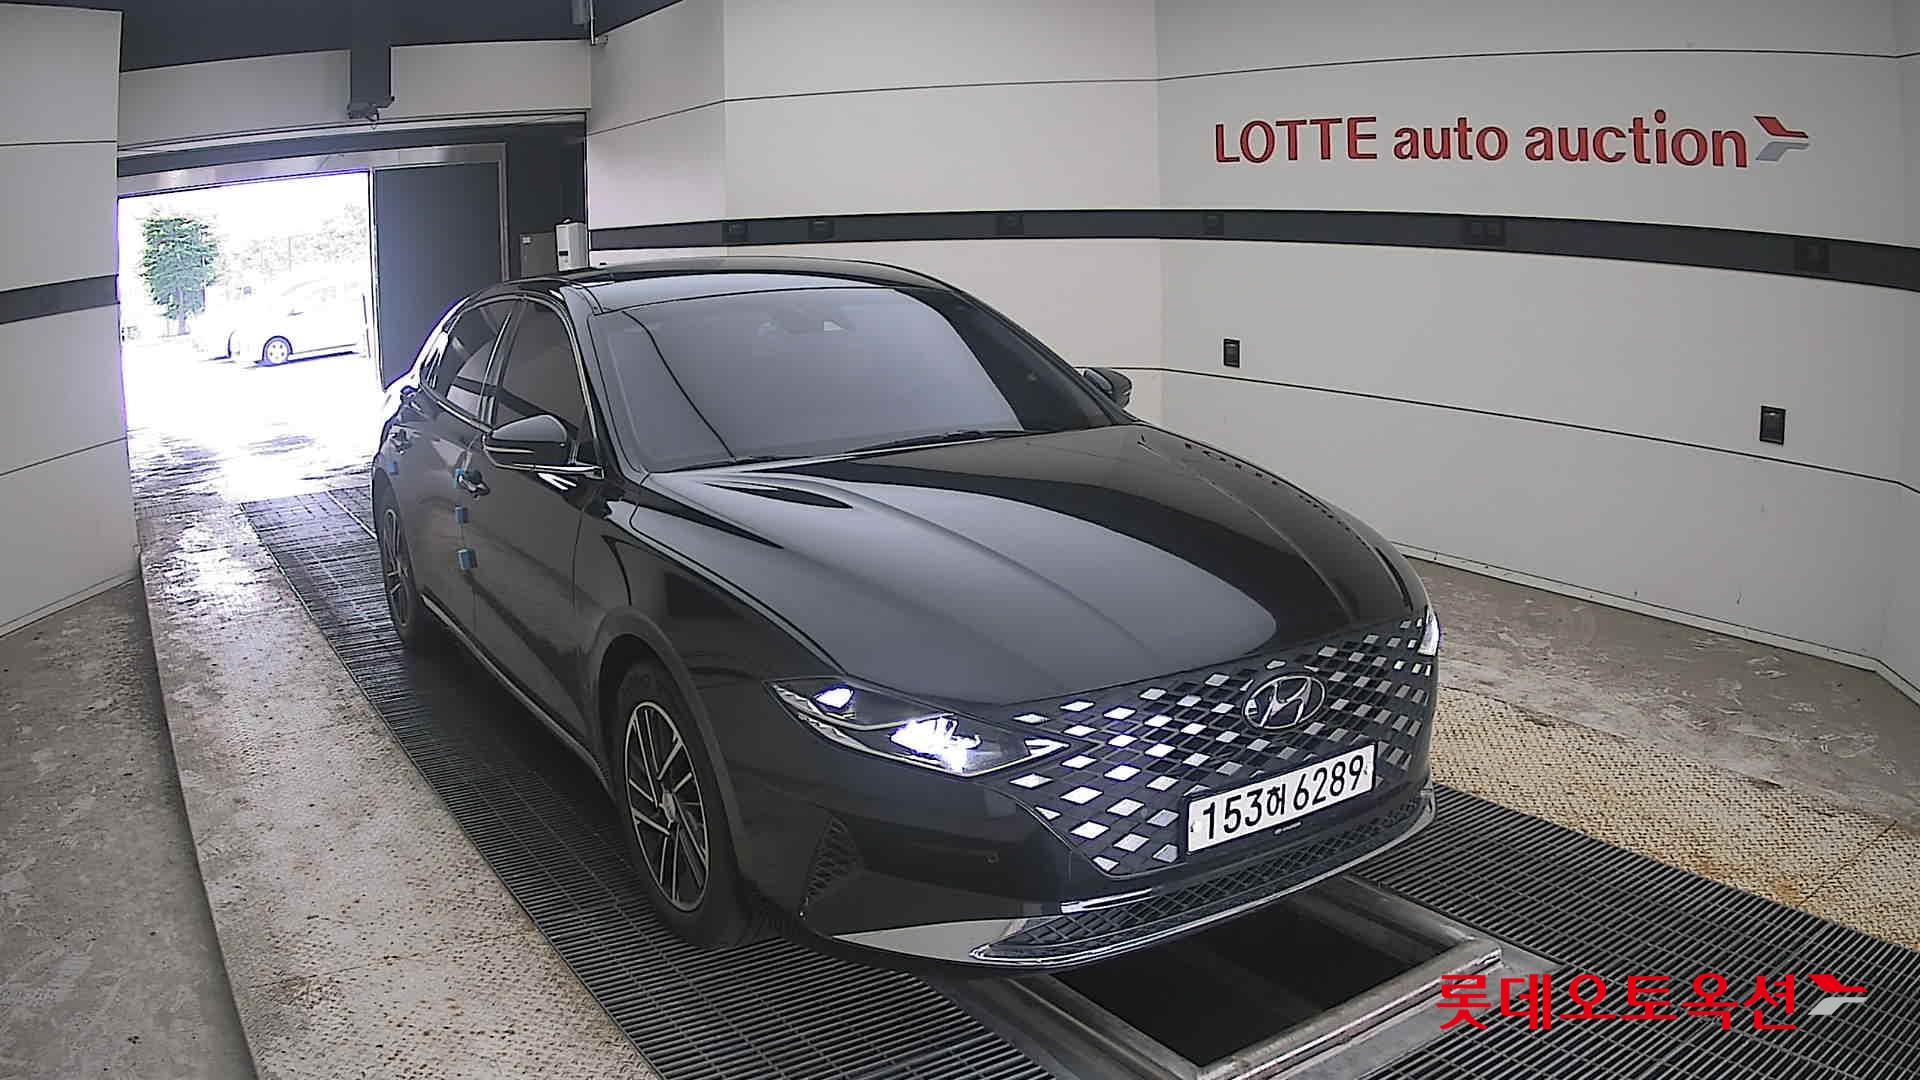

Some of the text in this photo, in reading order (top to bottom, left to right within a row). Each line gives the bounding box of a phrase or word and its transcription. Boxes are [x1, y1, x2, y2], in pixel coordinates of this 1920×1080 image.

[1215, 109, 1748, 168] LOTTE auto auction
[1293, 754, 1364, 811] 6289
